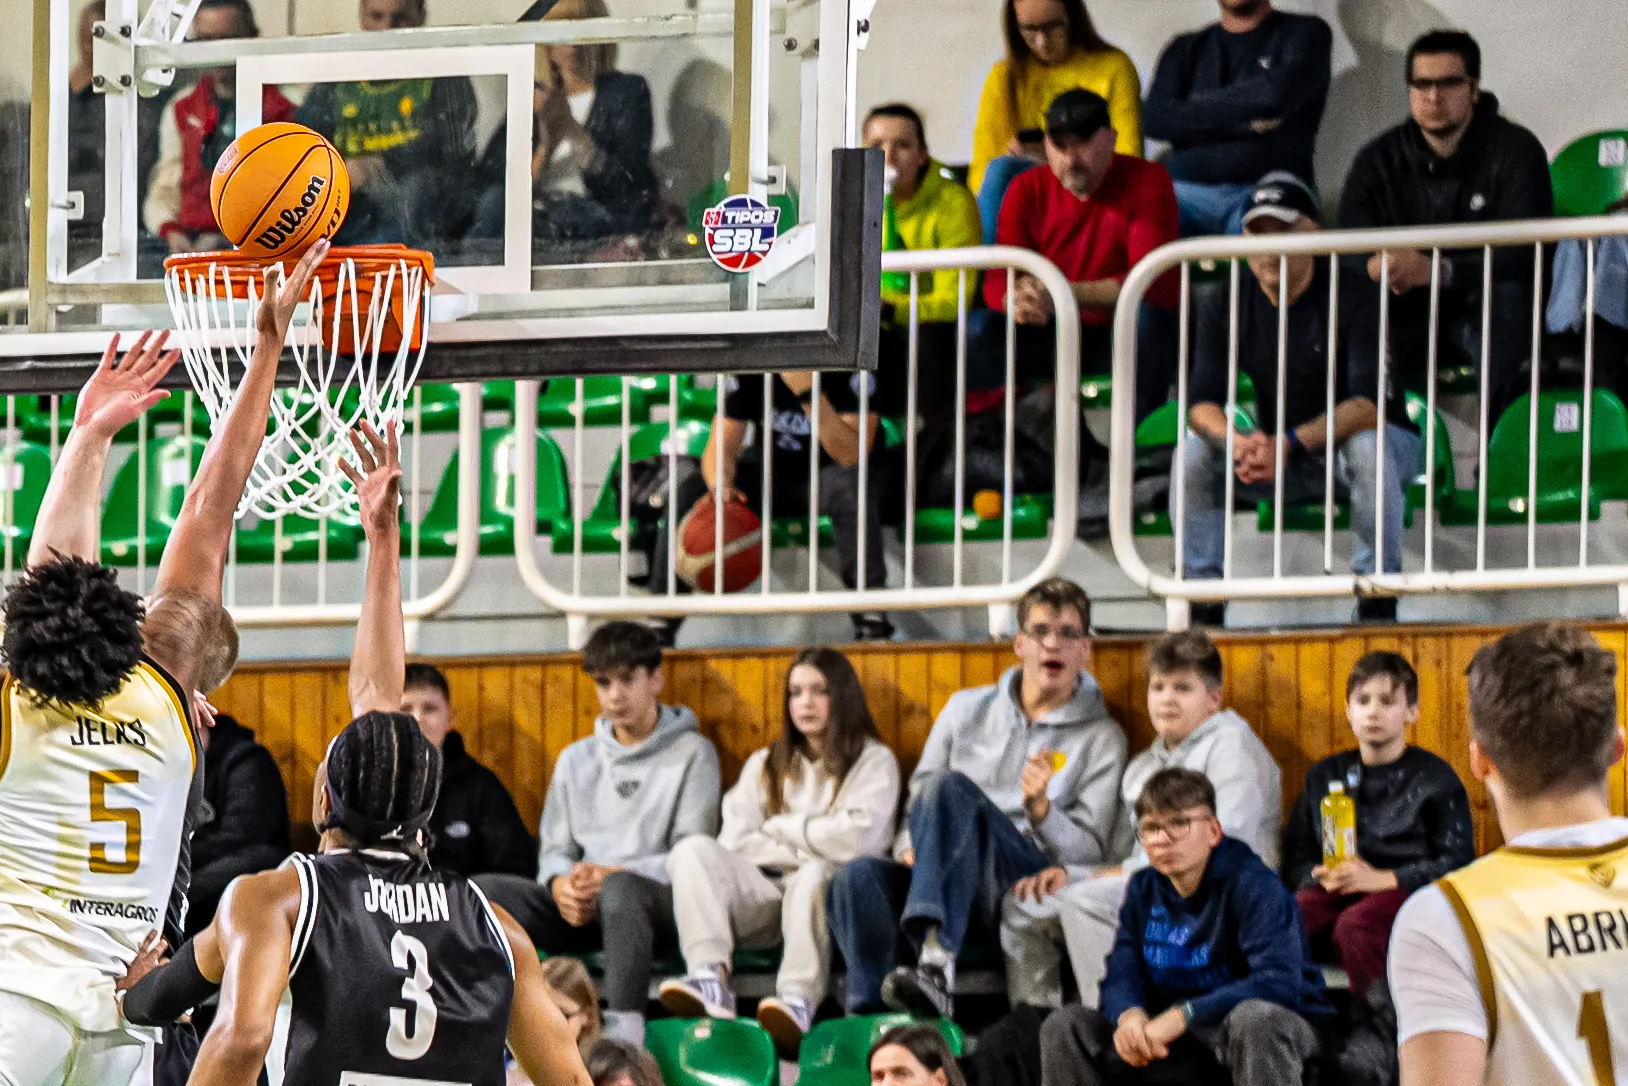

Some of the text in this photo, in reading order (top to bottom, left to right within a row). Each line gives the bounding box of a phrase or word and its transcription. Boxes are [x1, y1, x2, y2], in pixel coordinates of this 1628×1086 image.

[254, 175, 325, 250] Wilson
[725, 210, 776, 225] TIPOS
[712, 228, 770, 252] SBL
[70, 716, 146, 747] JELKS
[88, 769, 141, 875] 5
[70, 898, 159, 924] INTERAGRO
[364, 873, 450, 924] JORDAN
[386, 929, 438, 1061] 3
